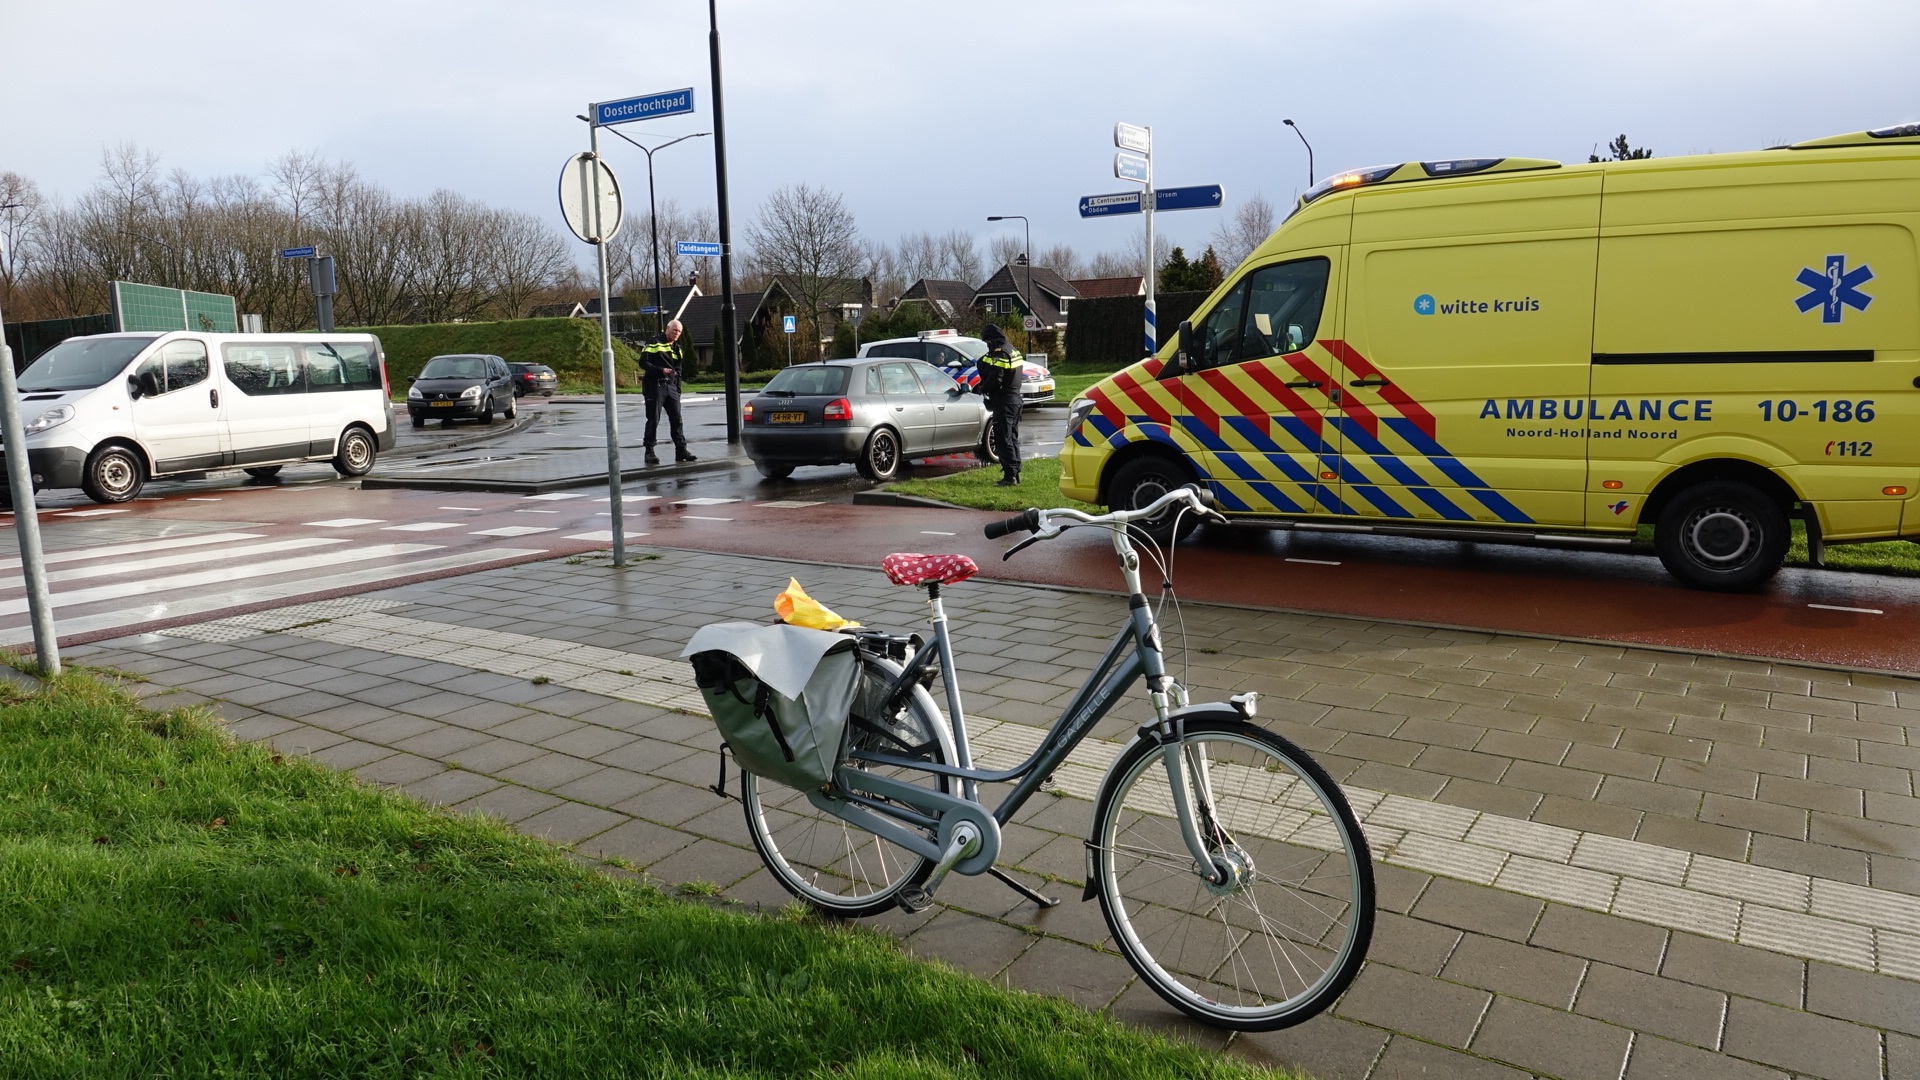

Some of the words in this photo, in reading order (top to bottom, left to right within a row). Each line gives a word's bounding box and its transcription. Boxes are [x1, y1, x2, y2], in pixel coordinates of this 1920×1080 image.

[604, 94, 685, 118] Oostertochtpad
[1096, 195, 1138, 204] Centrumwaard
[680, 244, 719, 254] Zuidtangent
[1440, 299, 1489, 315] witte
[1493, 296, 1540, 313] kruis
[772, 413, 802, 421] 54-HR-VT
[1479, 399, 1713, 421] AMBULANCE
[1757, 399, 1876, 423] 10-186
[1506, 428, 1622, 439] Noord-Holland
[1627, 429, 1678, 439] Noord
[1057, 686, 1111, 748] GAZELLE
